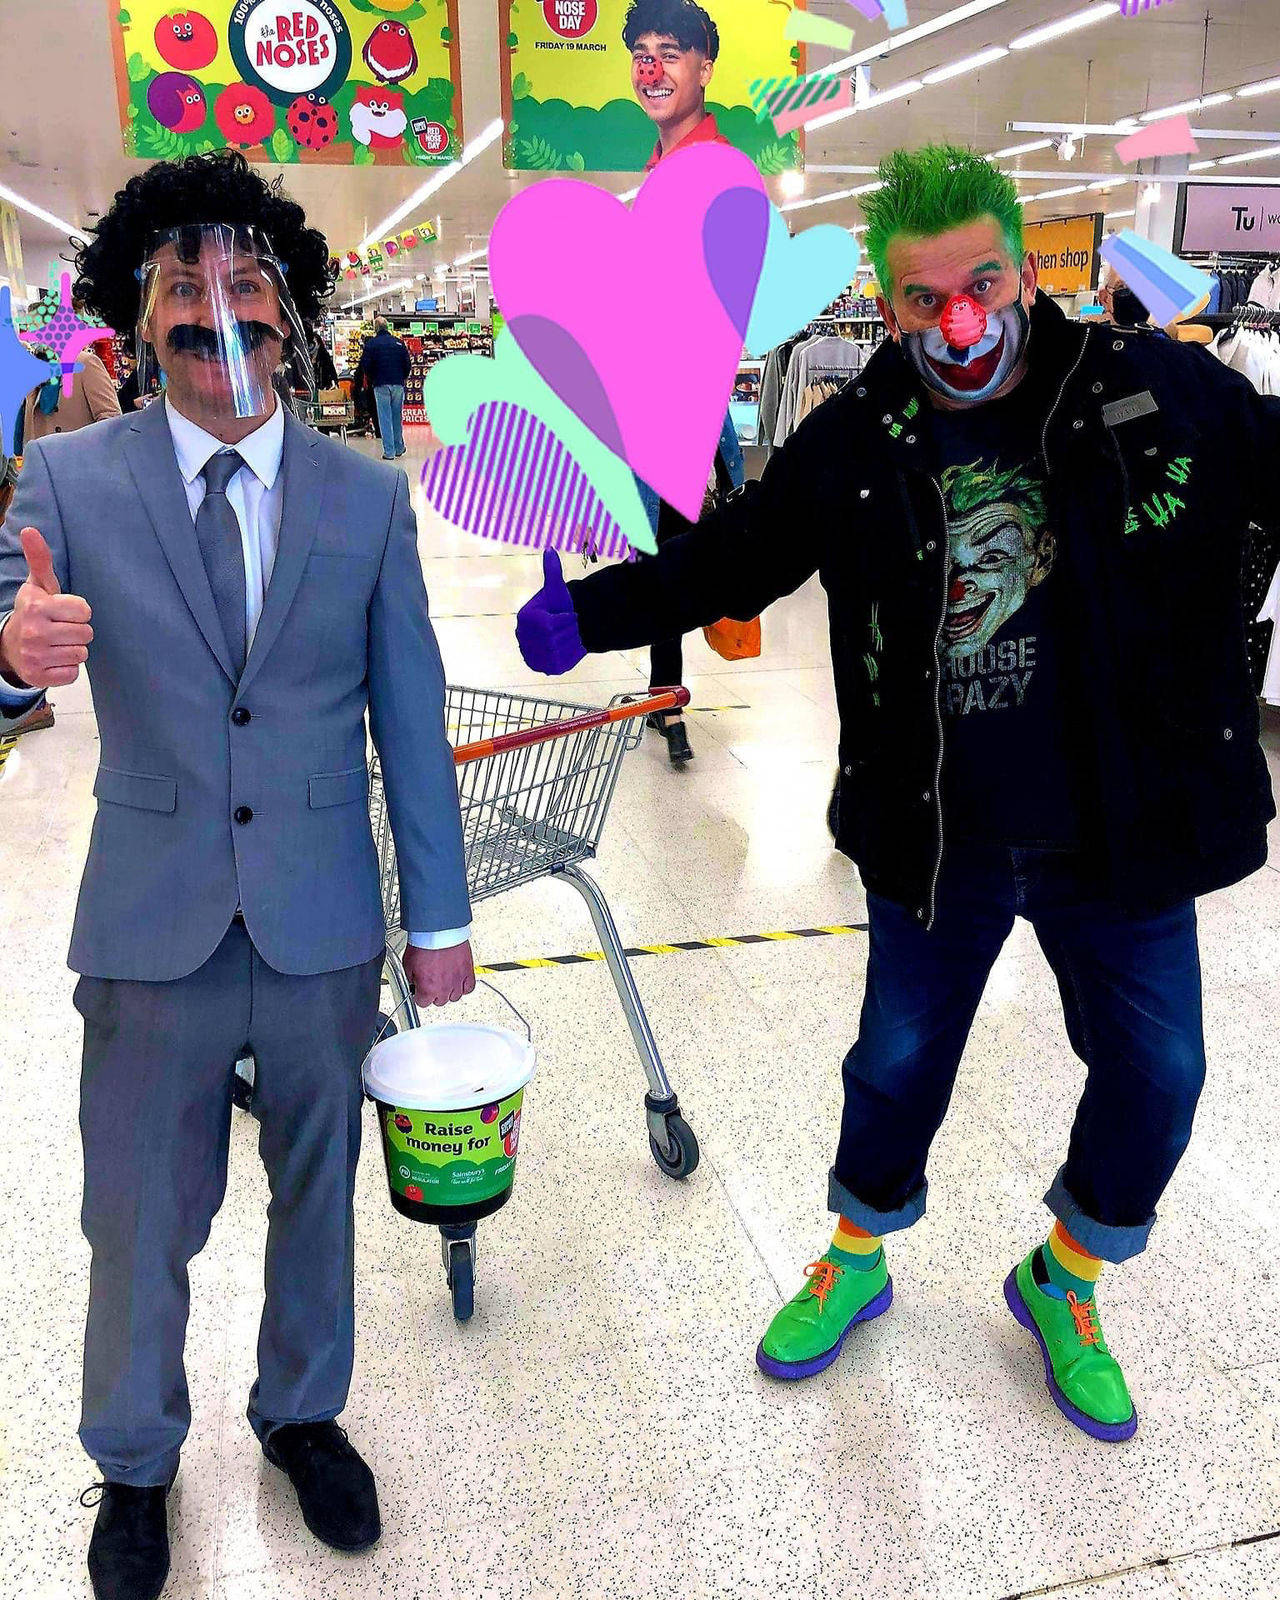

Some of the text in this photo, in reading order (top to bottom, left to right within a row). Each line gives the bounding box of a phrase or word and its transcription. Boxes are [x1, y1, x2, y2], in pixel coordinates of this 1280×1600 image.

[319, 0, 344, 34] noses
[555, 1, 586, 16] NOSE
[260, 11, 319, 43] the RED
[560, 15, 582, 30] DAY
[256, 33, 329, 68] NOSES
[535, 41, 607, 52] FRIDAY 19 MARCH
[1231, 206, 1255, 231] Tu
[1036, 246, 1089, 273] hen shop
[401, 408, 426, 416] GREAT
[946, 670, 1034, 716] RAZY
[424, 1122, 474, 1137] Raise
[405, 1136, 491, 1157] money for
